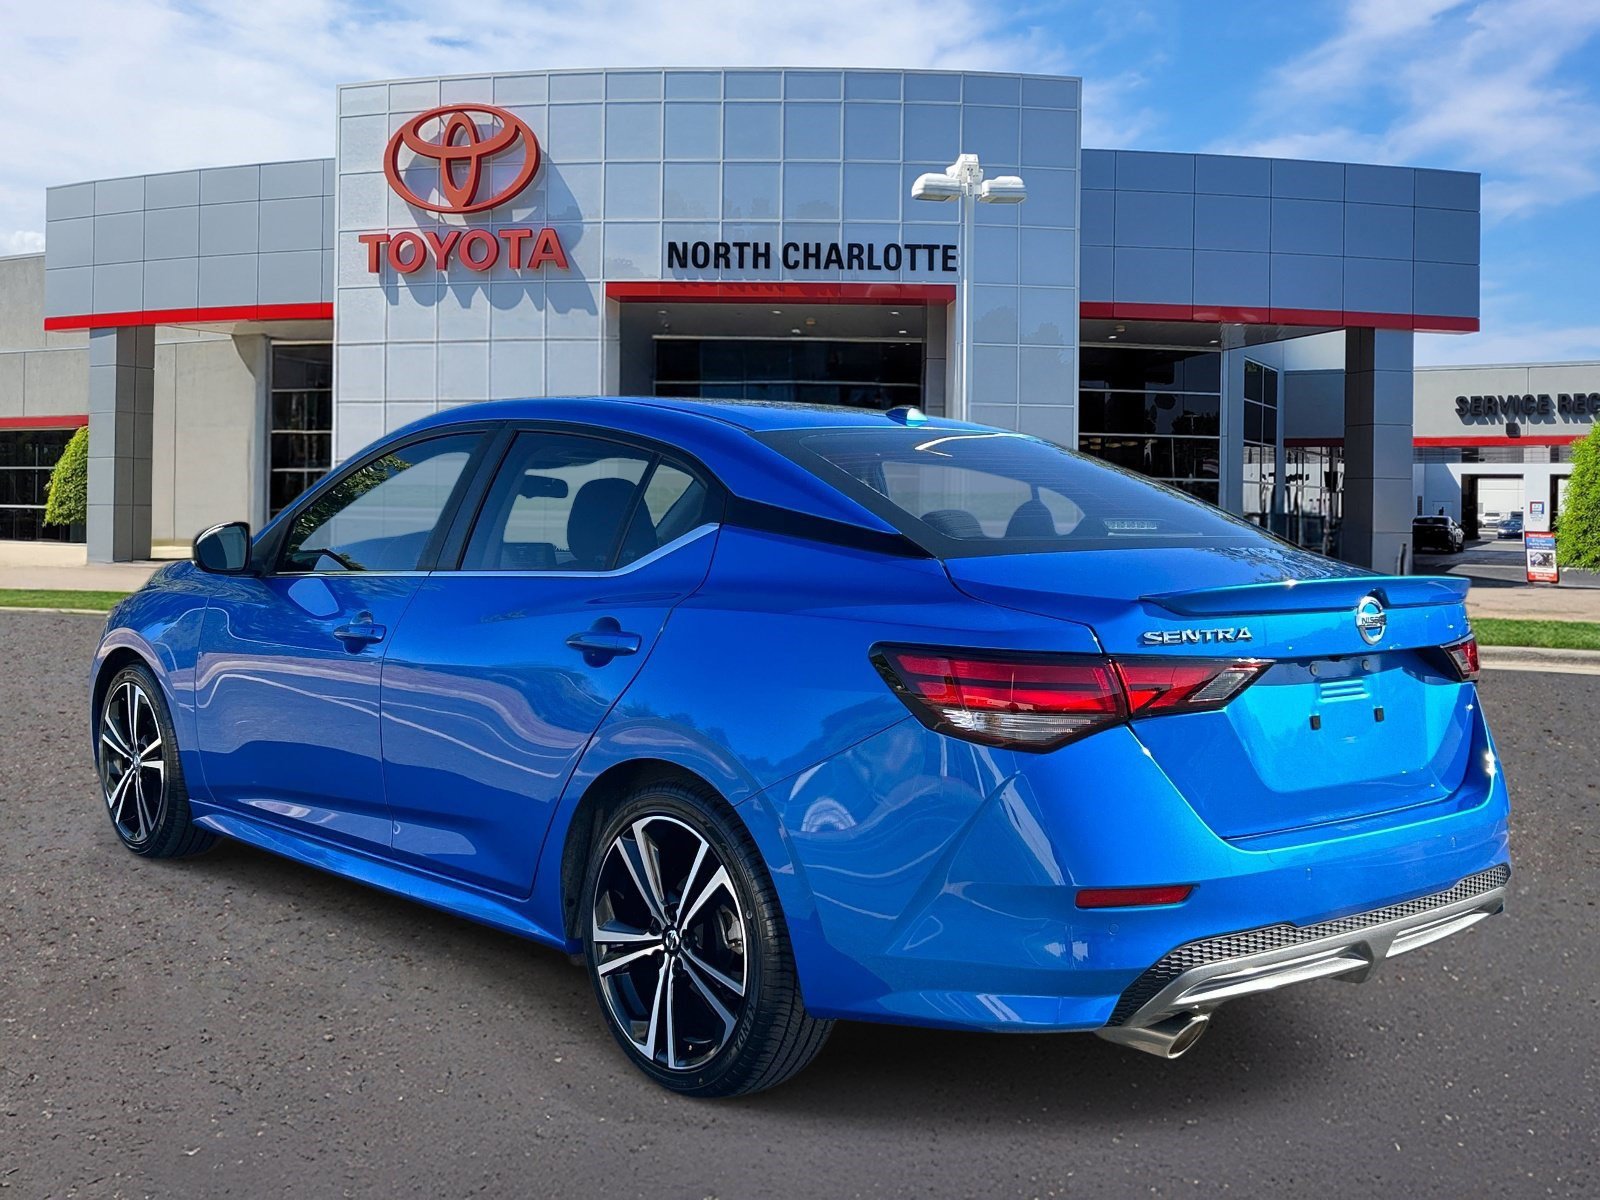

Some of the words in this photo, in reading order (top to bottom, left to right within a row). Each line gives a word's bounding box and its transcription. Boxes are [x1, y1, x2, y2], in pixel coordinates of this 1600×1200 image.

[358, 228, 569, 273] TOYOTA
[667, 241, 771, 270] NORTH
[781, 242, 958, 272] CHARLOTTE
[1455, 394, 1551, 417] SERVICE
[1557, 392, 1600, 415] REC
[1142, 626, 1253, 645] SENTRA
